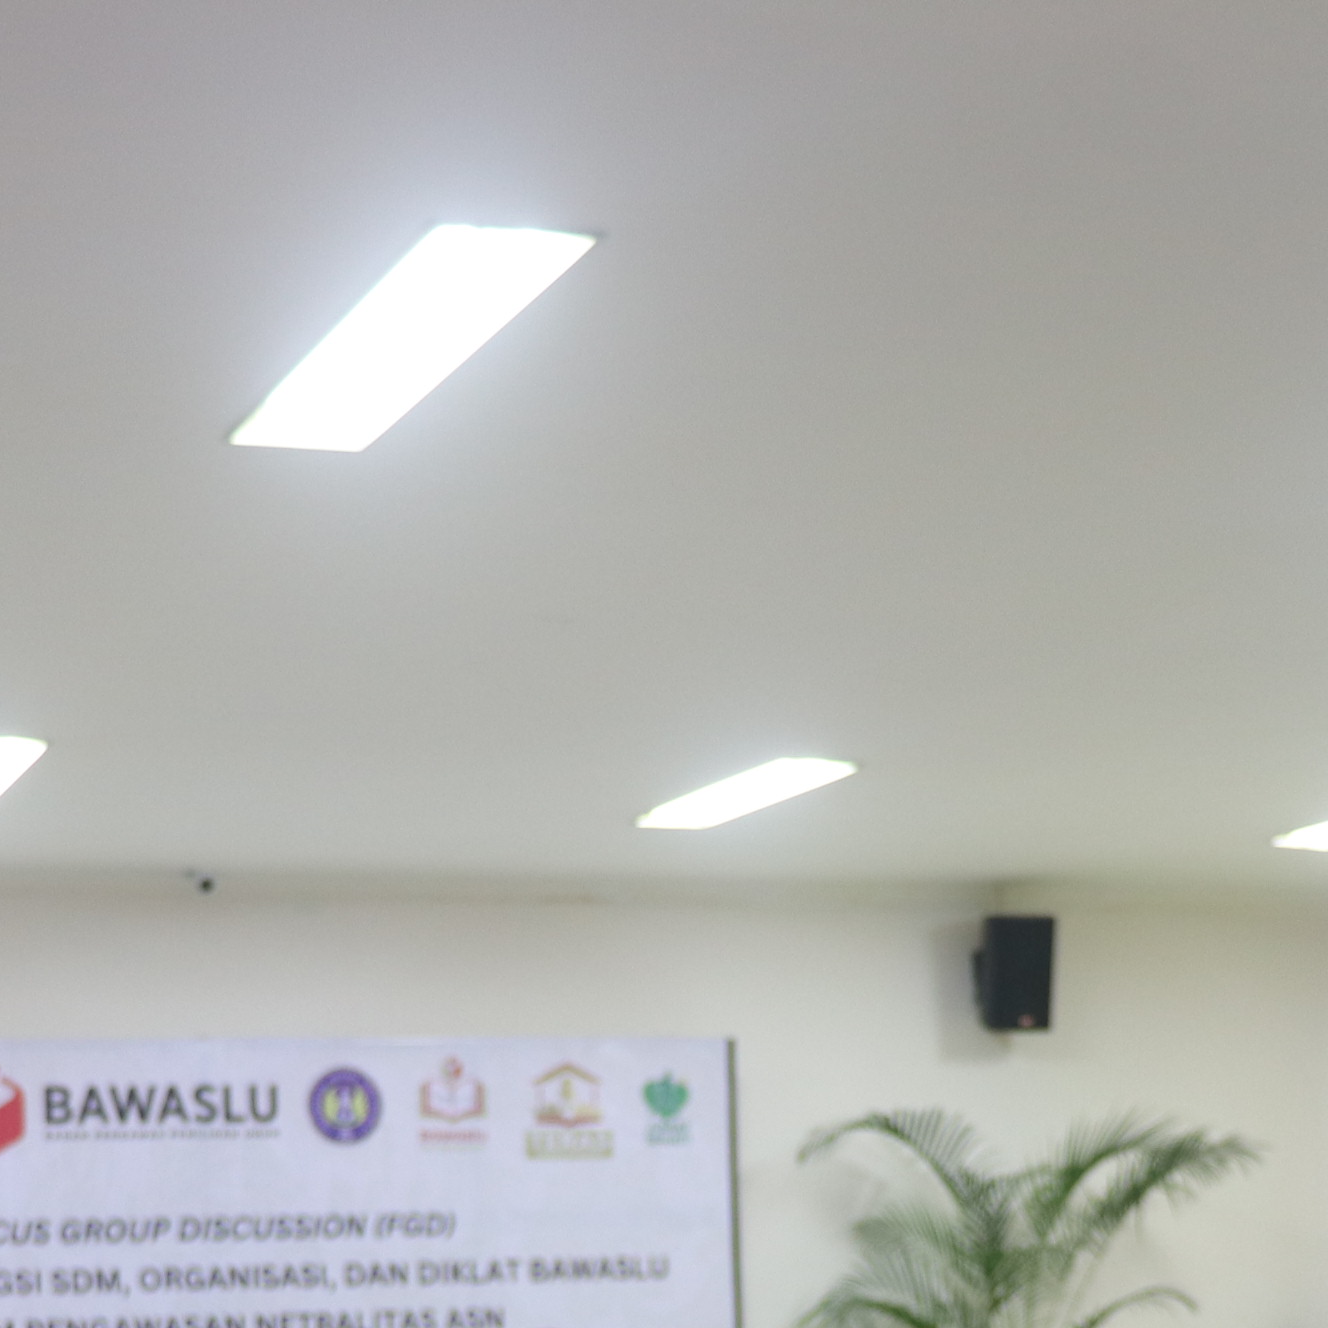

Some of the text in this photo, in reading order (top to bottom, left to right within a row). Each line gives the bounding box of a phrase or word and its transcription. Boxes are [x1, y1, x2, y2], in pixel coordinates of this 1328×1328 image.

[43, 1083, 279, 1126] BAWASLU
[58, 1215, 173, 1246] GROUP
[176, 1212, 369, 1244] DISCUSSION
[372, 1209, 458, 1242] (FGD)
[50, 1266, 131, 1298] SDM,
[137, 1262, 338, 1295] ORGANISASI,
[343, 1260, 410, 1289] DAN
[416, 1257, 521, 1287] DIKLAT
[527, 1254, 671, 1284] BAWASLU
